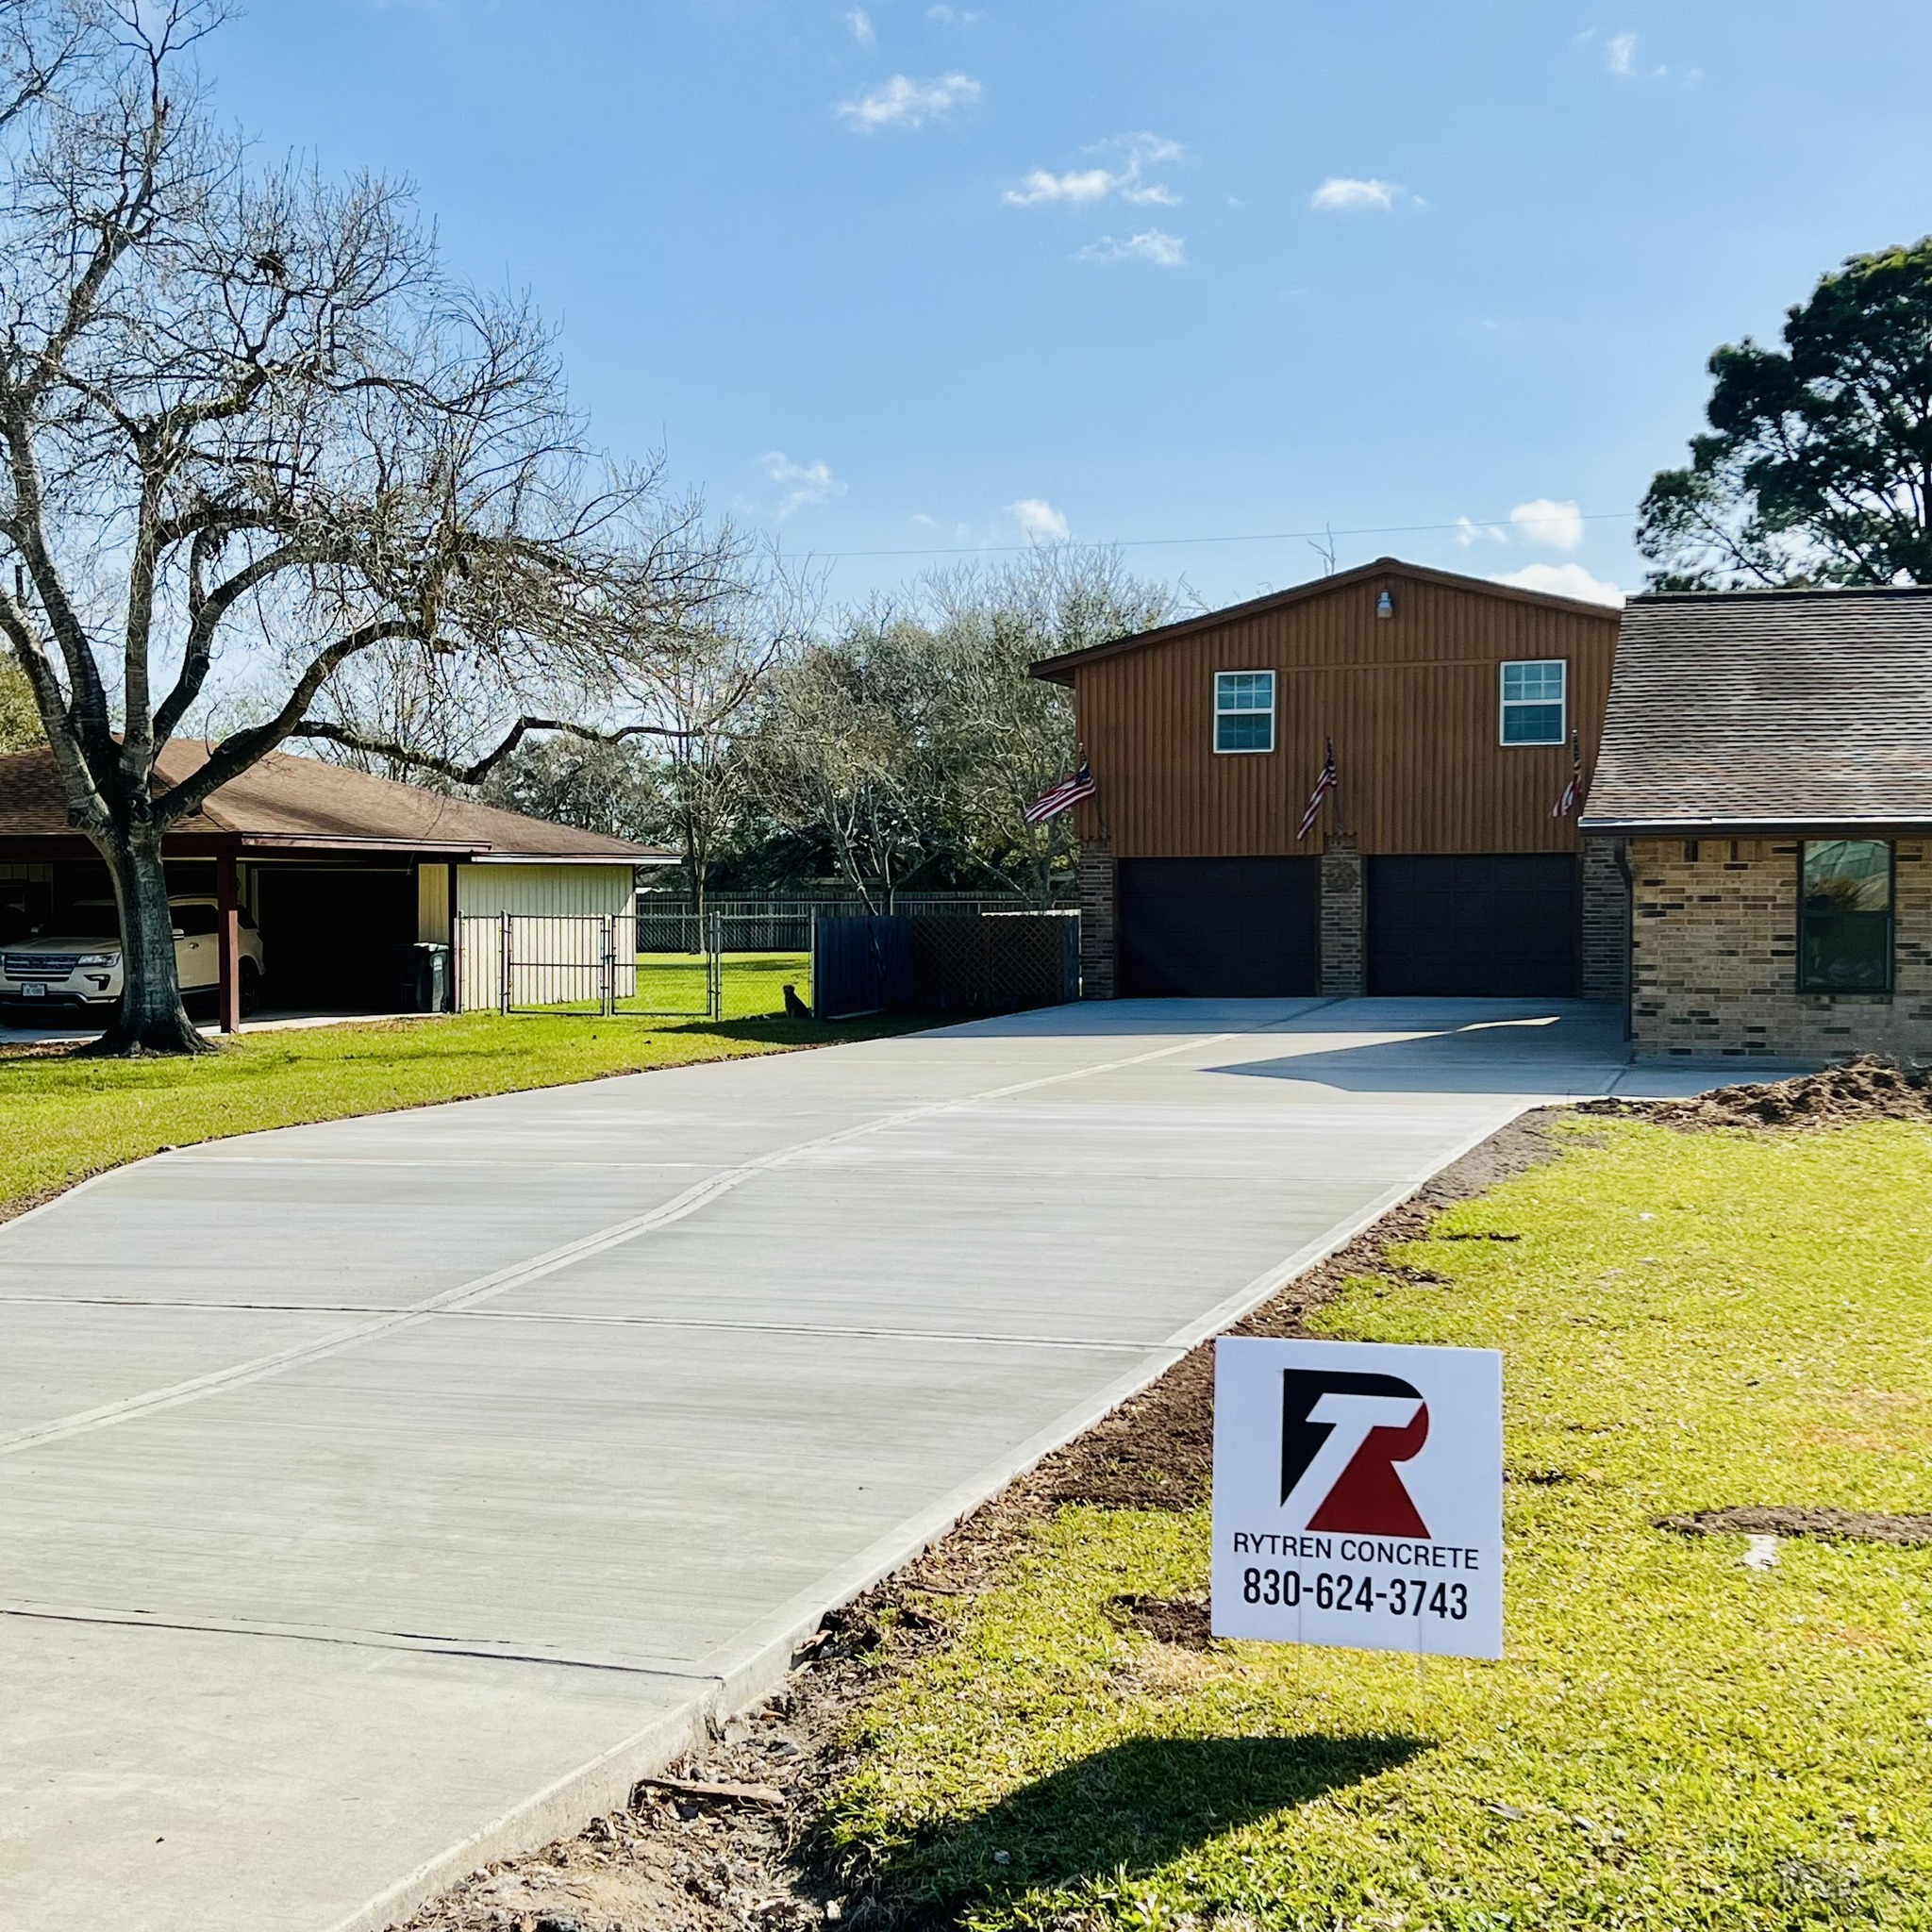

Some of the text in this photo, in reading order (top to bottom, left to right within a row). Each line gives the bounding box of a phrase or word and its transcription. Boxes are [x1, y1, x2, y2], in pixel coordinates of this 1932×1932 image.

[1233, 1531, 1479, 1571] RYTREN CONCRETE
[1242, 1567, 1469, 1621] 830-624-3743
